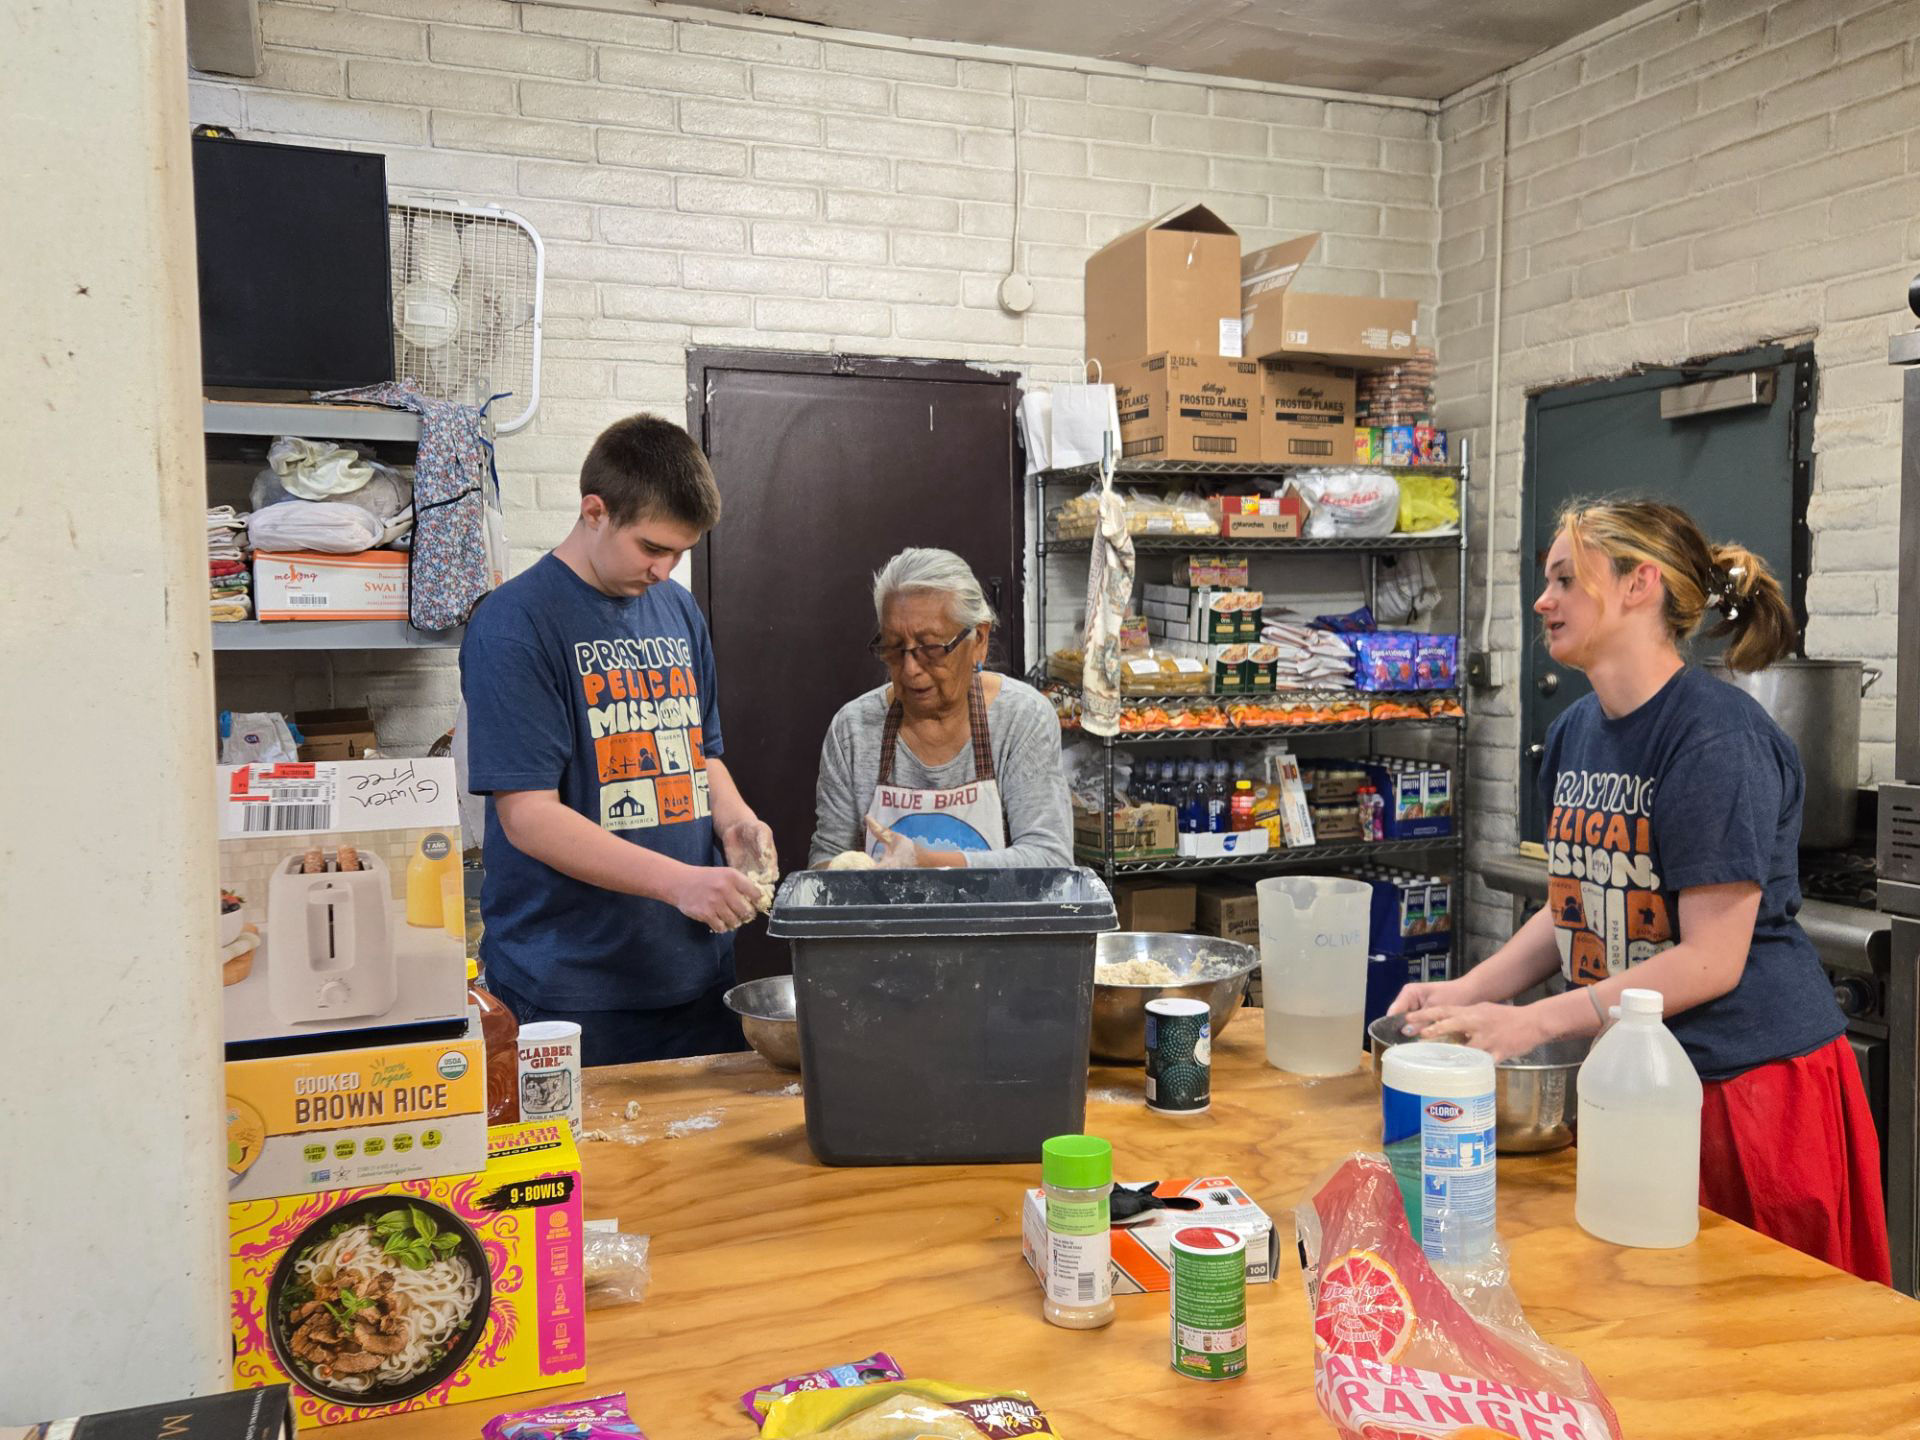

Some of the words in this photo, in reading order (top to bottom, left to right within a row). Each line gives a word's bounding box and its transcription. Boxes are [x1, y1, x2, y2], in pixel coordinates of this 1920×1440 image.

[1124, 394, 1149, 408] FLAKES
[1180, 394, 1215, 407] FROSTED
[1217, 396, 1248, 408] FLAKES
[1275, 398, 1311, 410] FROSTED
[1313, 400, 1344, 412] FLAKES
[1200, 411, 1232, 420] CHOCOLATE
[1296, 414, 1329, 423] CHOCOLATE
[1272, 522, 1289, 530] Beef
[364, 581, 398, 593] SWAI
[574, 637, 692, 676] PRAYING
[347, 760, 415, 790] Free
[350, 779, 439, 808] Gluten
[881, 790, 922, 810] BLUE
[934, 787, 978, 809] BIRD
[1553, 770, 1656, 817] RAYING
[1548, 806, 1650, 853] ELICA
[519, 1045, 573, 1061] CLABBER
[444, 1057, 462, 1066] USDA
[530, 1057, 561, 1069] GIRL
[295, 1072, 361, 1096] COOKED
[371, 1067, 413, 1088] Organic
[295, 1090, 384, 1124] BROWN
[394, 1083, 448, 1114] RICE
[1430, 1106, 1459, 1117] CLOROX
[428, 1131, 435, 1140] 6
[1249, 1266, 1266, 1275] 100
[1325, 1354, 1428, 1390] ARA
[970, 1400, 1035, 1418] ORIGINAL
[1328, 1381, 1586, 1440] RANGE
